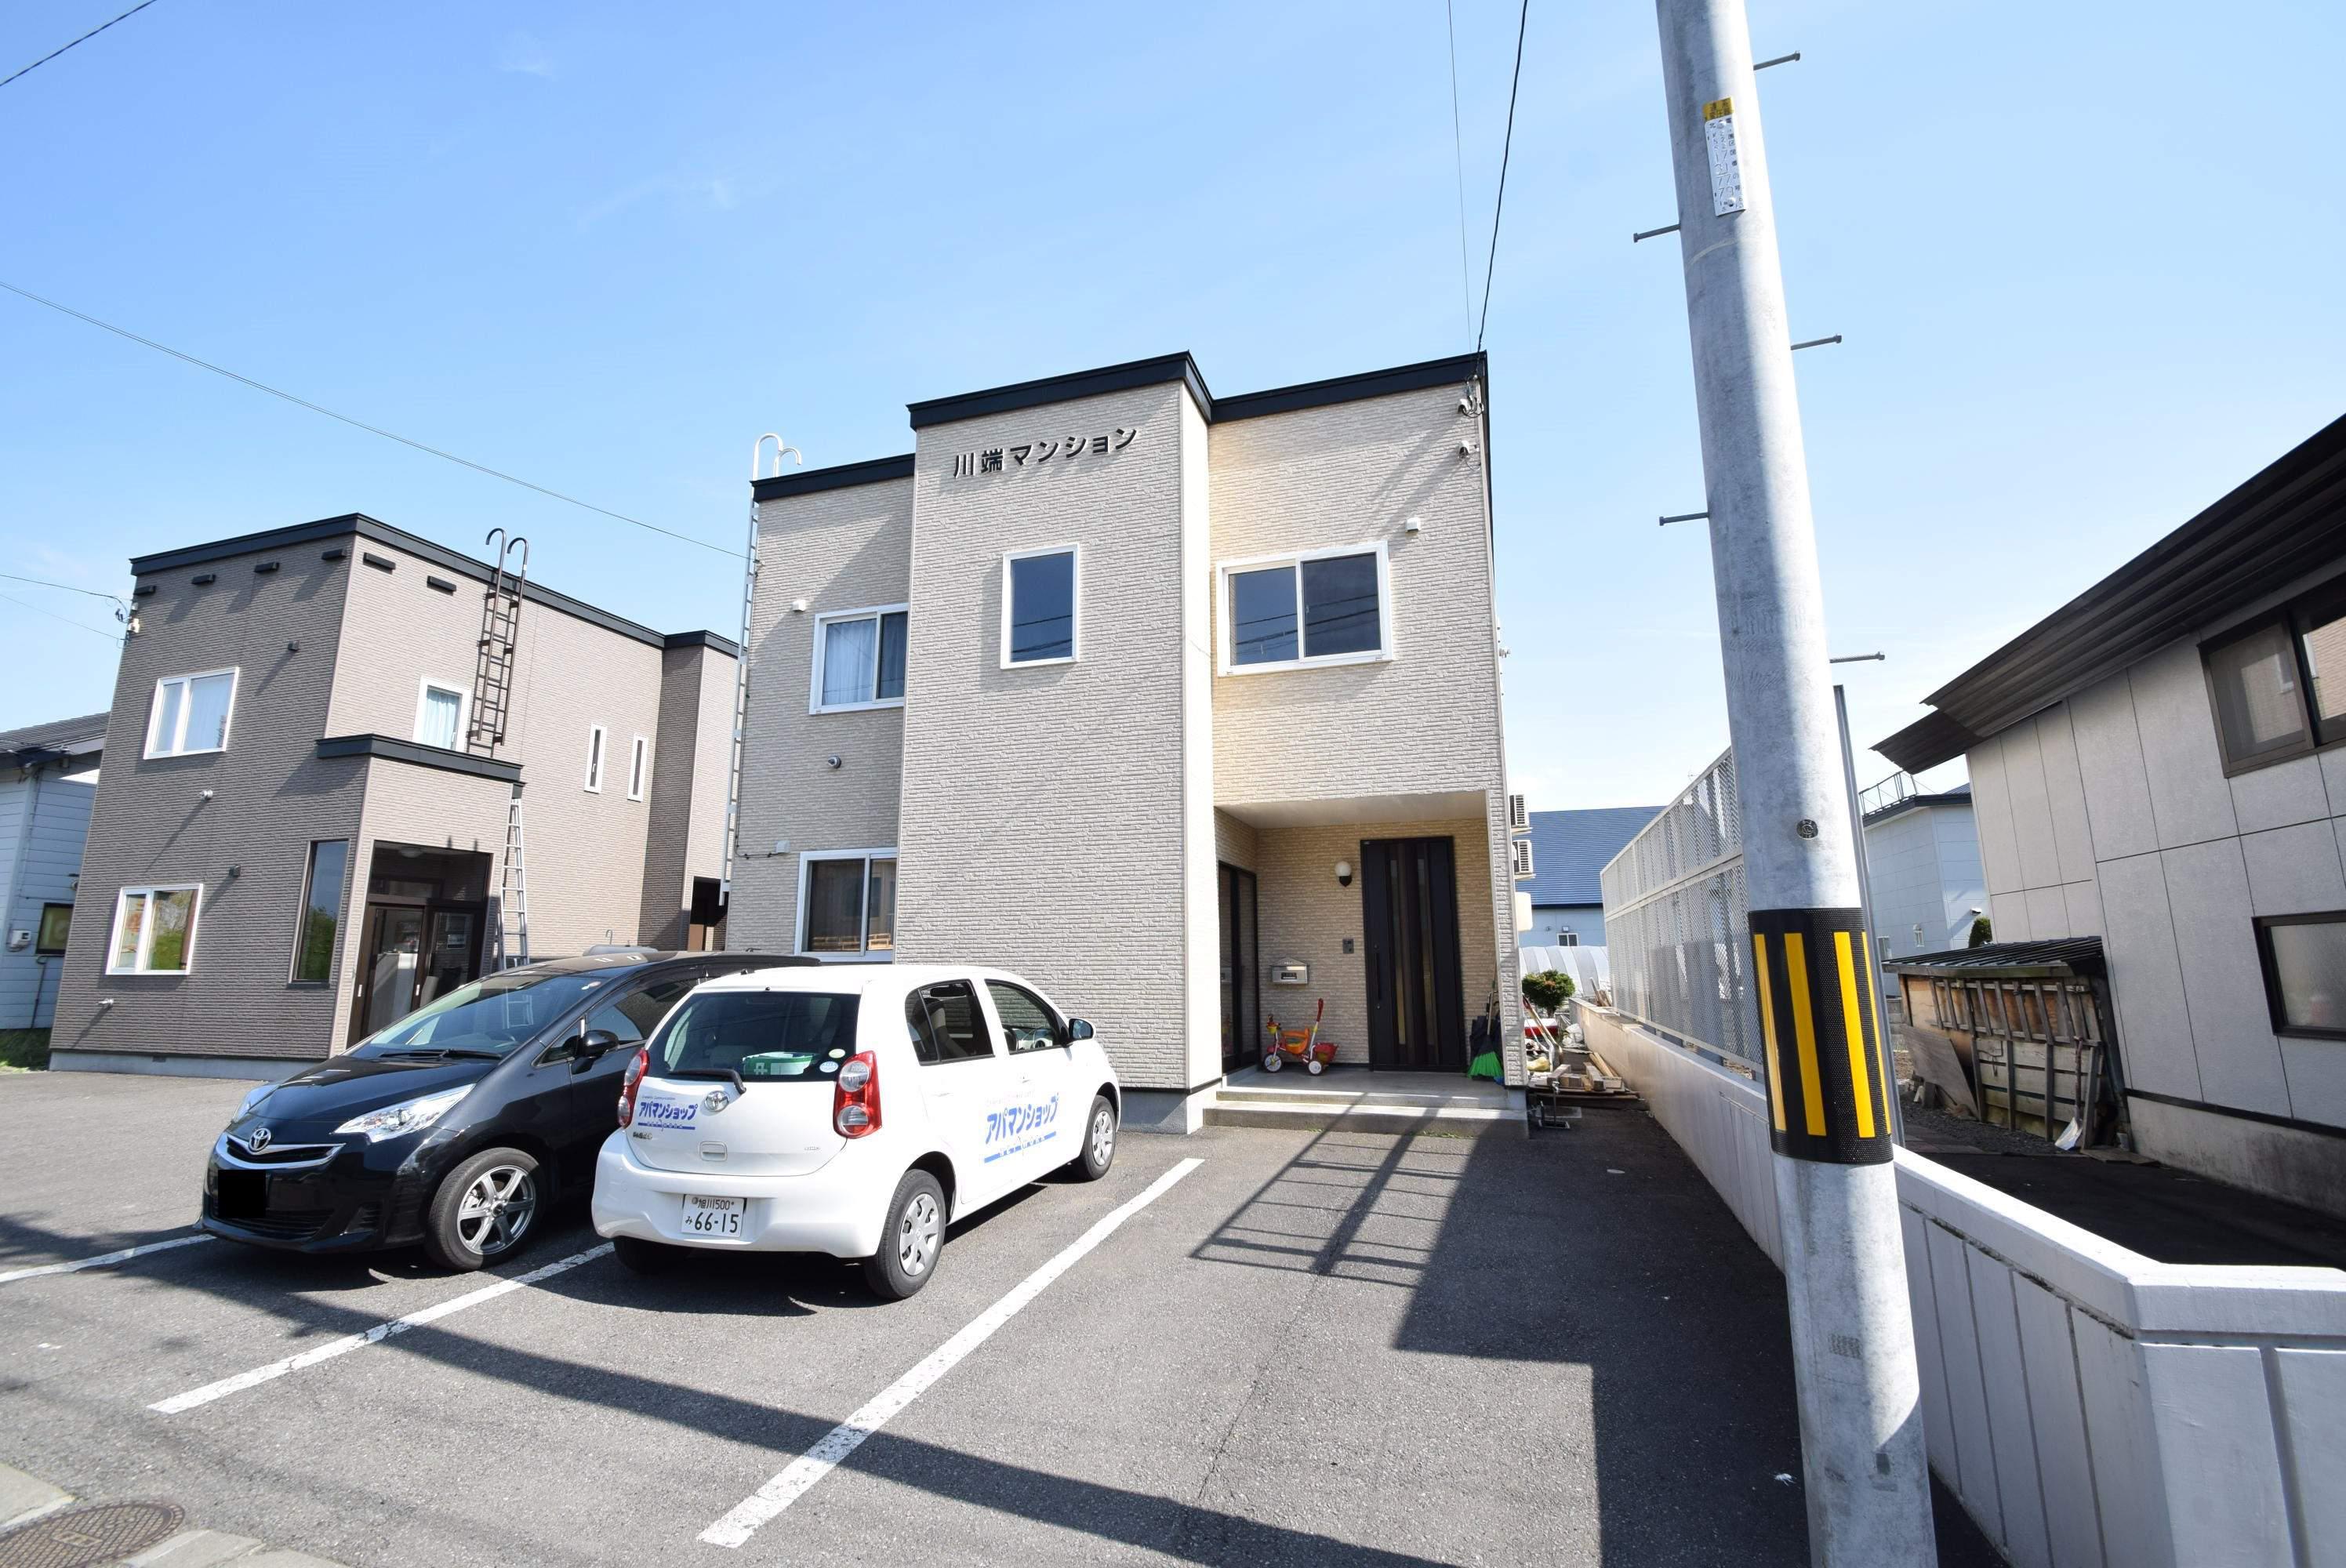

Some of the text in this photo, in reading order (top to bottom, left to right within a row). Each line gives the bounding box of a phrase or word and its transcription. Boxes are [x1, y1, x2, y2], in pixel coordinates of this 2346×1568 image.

[953, 428, 1137, 478] 川端マンション
[639, 1101, 699, 1121] アパマンショップ
[986, 1091, 1059, 1145] アパマンショップ
[695, 1212, 739, 1233] 66-15
